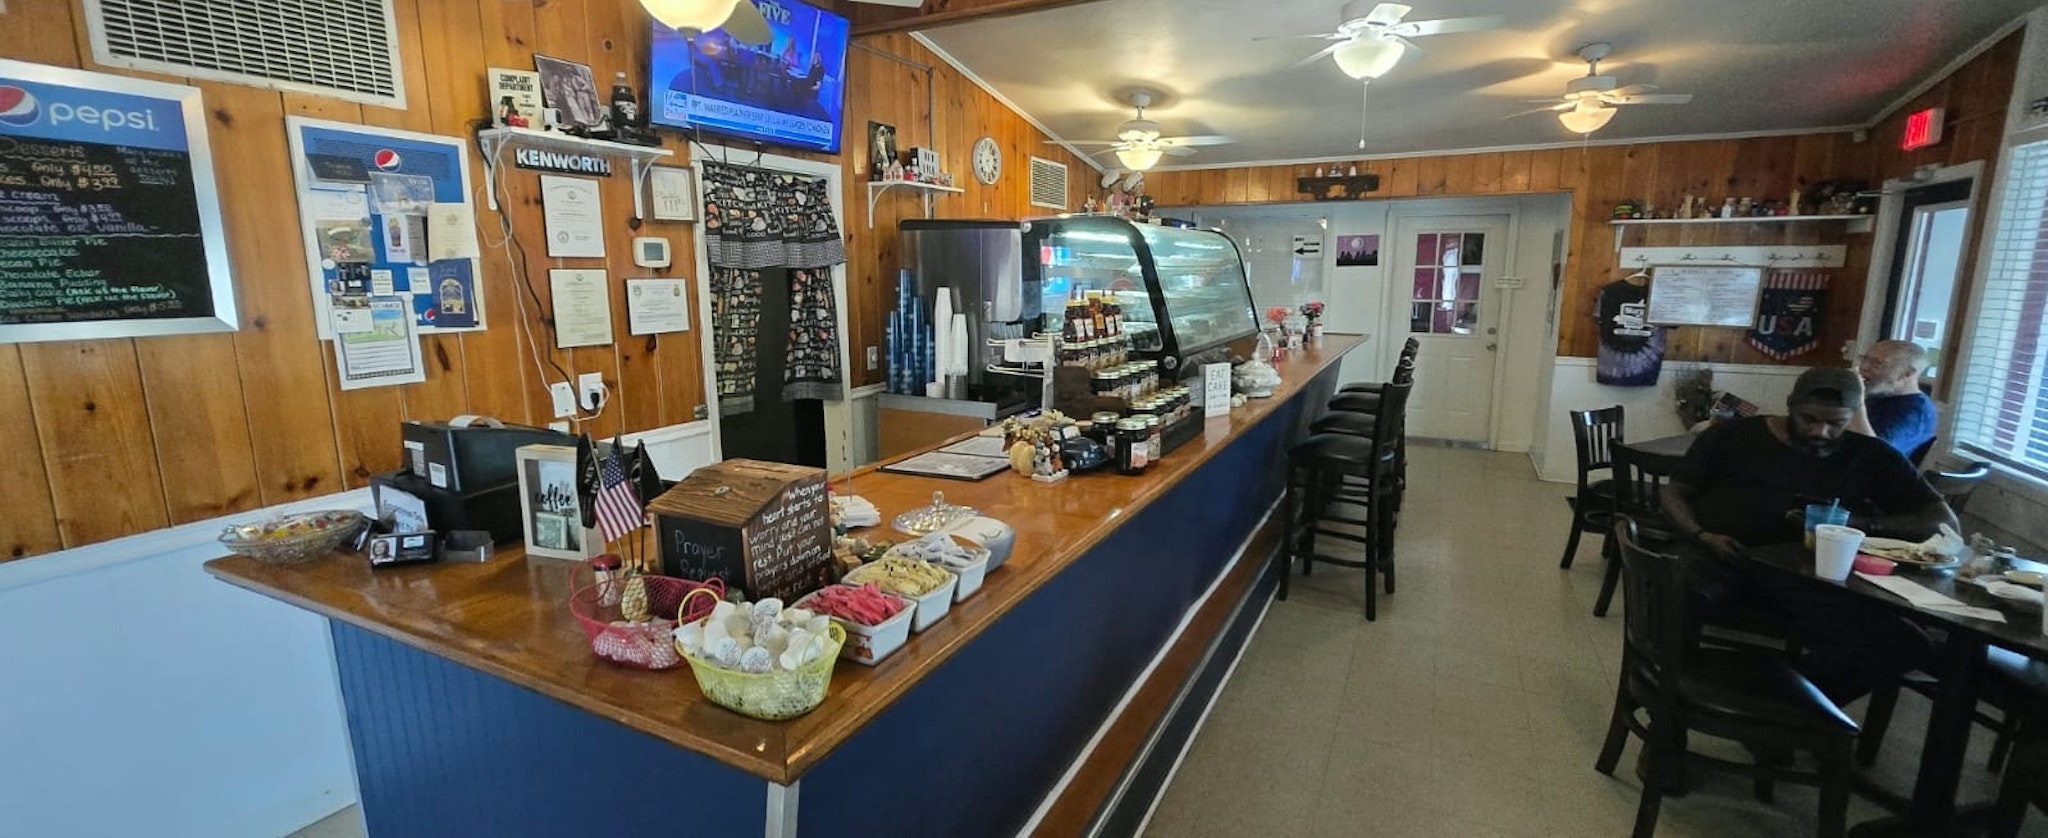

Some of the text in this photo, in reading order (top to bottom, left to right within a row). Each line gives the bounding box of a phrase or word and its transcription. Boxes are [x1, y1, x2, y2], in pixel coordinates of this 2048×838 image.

[50, 102, 156, 132] pepsi
[516, 148, 611, 173] KENWORTH
[0, 223, 60, 233] hocolate
[1758, 314, 1812, 337] USA
[781, 517, 799, 531] and
[675, 529, 727, 569] Prayer
